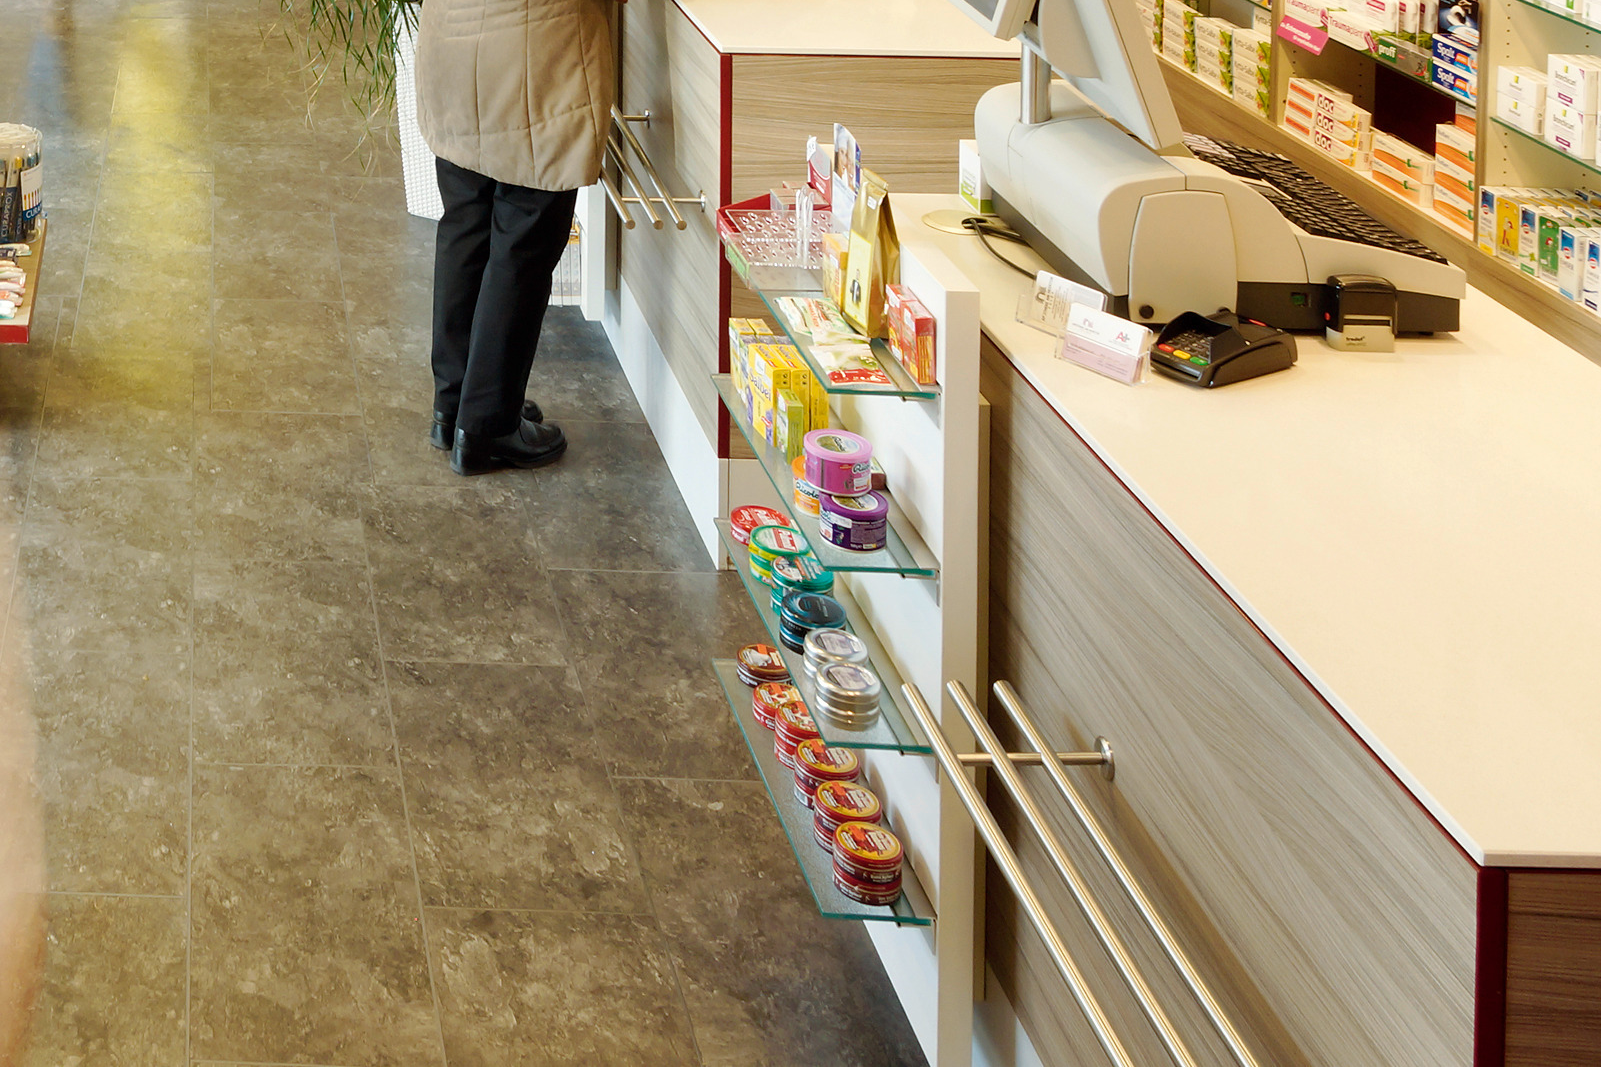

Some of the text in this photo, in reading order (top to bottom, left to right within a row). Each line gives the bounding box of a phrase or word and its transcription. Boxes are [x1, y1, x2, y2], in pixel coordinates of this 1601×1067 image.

[1329, 15, 1364, 37] Traumaplant
[1378, 44, 1397, 58] proff
[1437, 42, 1455, 59] Spalt
[1437, 67, 1454, 84] Spalt
[1317, 93, 1335, 114] doc
[1316, 112, 1334, 132] doc
[1315, 132, 1333, 152] doc
[0, 190, 13, 238] CURAPROX
[26, 202, 42, 219] CURA
[852, 462, 871, 473] Ricola
